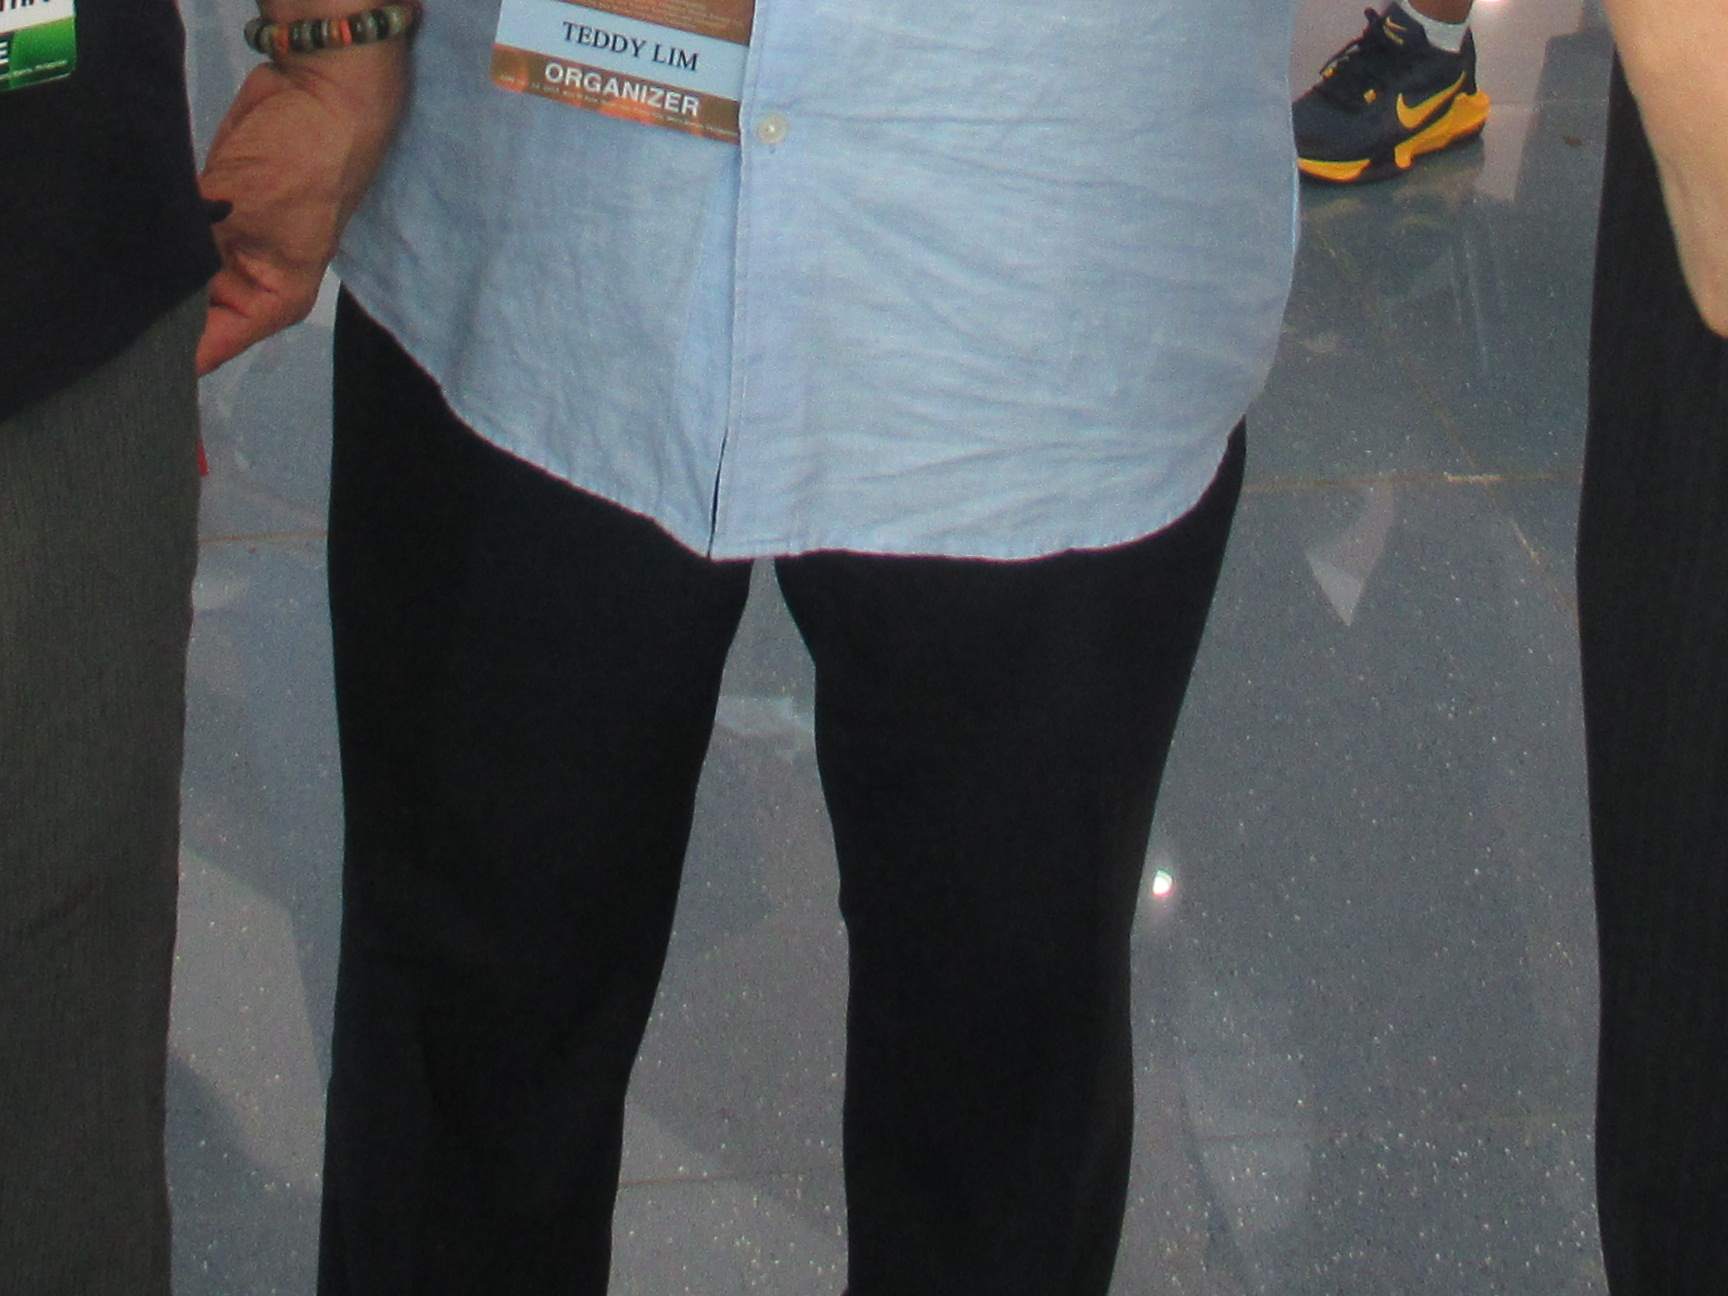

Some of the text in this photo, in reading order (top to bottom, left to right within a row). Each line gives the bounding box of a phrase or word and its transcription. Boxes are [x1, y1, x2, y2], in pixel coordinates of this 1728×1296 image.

[562, 21, 700, 72] TEDDY LIM
[544, 61, 700, 117] ORGANIZER
